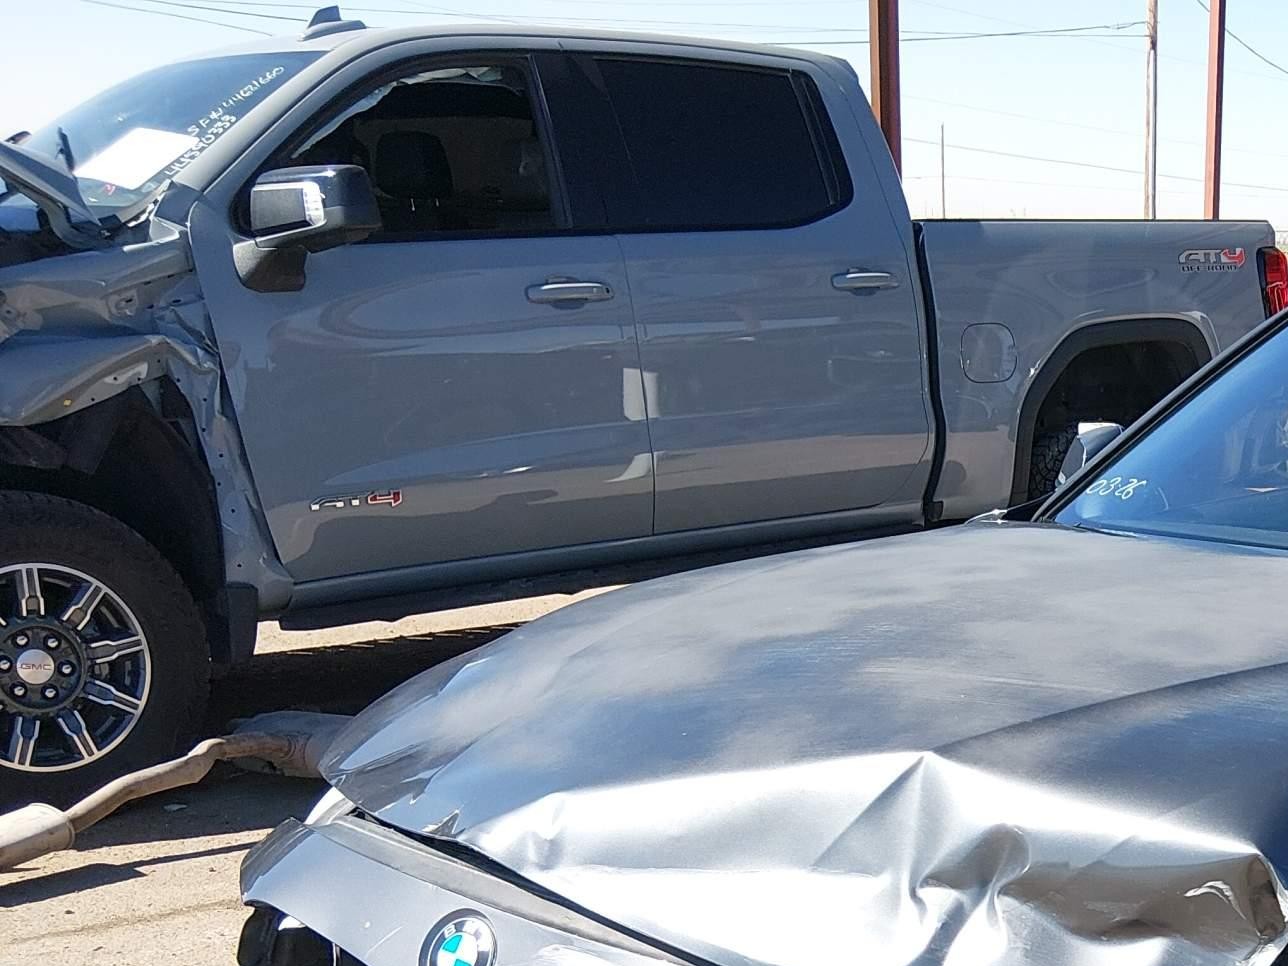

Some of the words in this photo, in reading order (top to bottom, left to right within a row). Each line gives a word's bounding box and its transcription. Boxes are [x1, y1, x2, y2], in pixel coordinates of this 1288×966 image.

[1178, 247, 1246, 267] AT4
[310, 489, 402, 511] AT4
[19, 663, 53, 671] GMC
